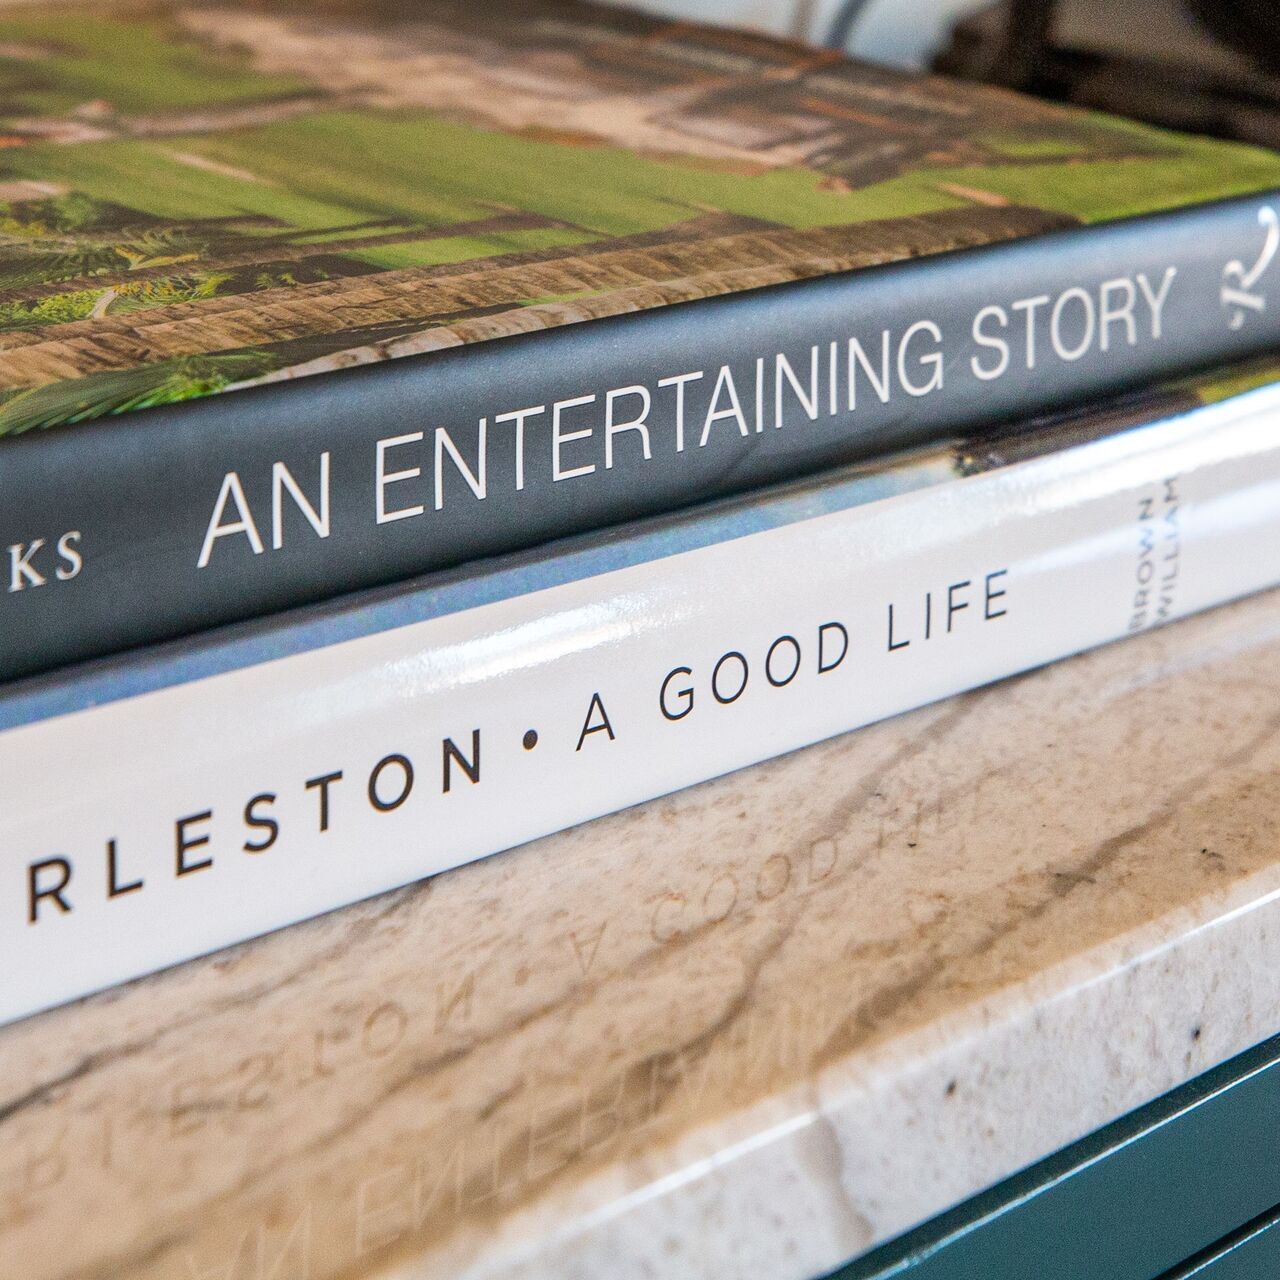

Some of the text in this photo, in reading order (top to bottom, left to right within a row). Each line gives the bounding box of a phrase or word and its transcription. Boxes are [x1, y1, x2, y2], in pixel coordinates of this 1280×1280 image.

[195, 264, 1178, 570] AN ENTERTAINING STORY
[1127, 496, 1155, 631] BROWN
[575, 690, 617, 753] A
[657, 619, 851, 723] GOOD
[886, 568, 1010, 654] LIFE
